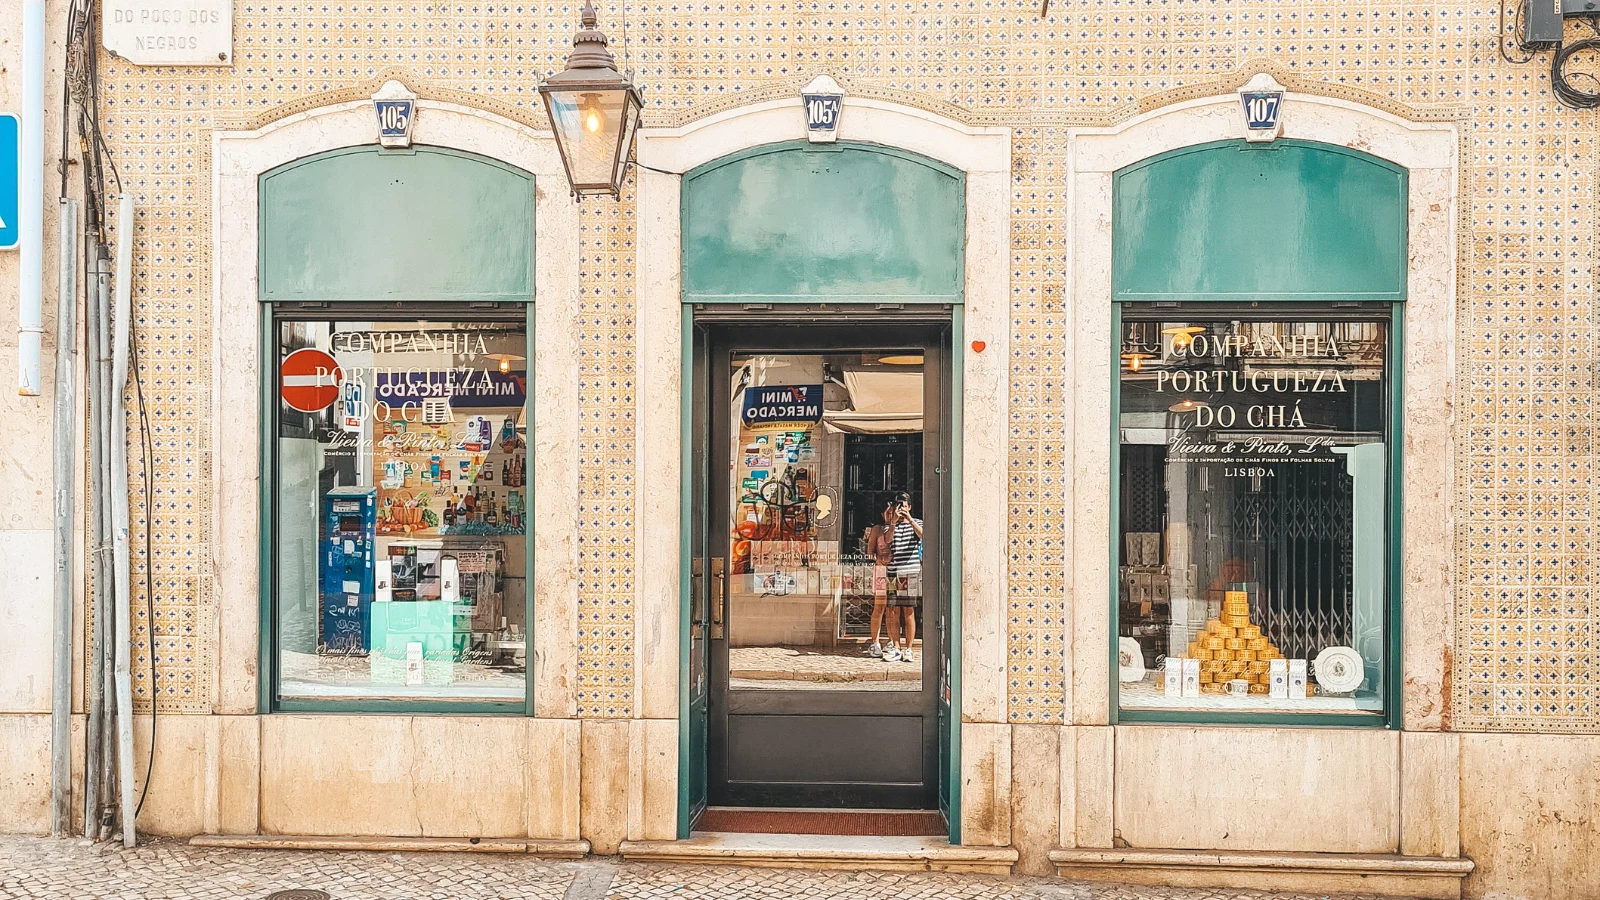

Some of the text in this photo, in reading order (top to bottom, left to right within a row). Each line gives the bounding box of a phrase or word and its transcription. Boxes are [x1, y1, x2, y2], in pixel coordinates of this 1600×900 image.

[114, 9, 219, 25] DO POÇO DOS
[135, 36, 198, 50] NEGROS
[379, 105, 407, 130] 105
[1247, 98, 1278, 122] 107
[329, 332, 490, 355] COMPANHIA
[1169, 334, 1341, 358] COMPANHIA
[314, 365, 496, 389] PORTUGUEZA
[1155, 369, 1348, 393] PORTUGUEZA
[353, 395, 457, 423] DO CHÁ
[1194, 399, 1307, 428] DO CHÁ
[327, 430, 373, 449] Vieira
[1168, 436, 1217, 454] Vieira
[1221, 441, 1236, 454] &
[1240, 436, 1292, 456] Pinto,
[1224, 467, 1275, 477] LISBOA
[460, 655, 493, 665] Gardens
[461, 646, 493, 658] Origens
